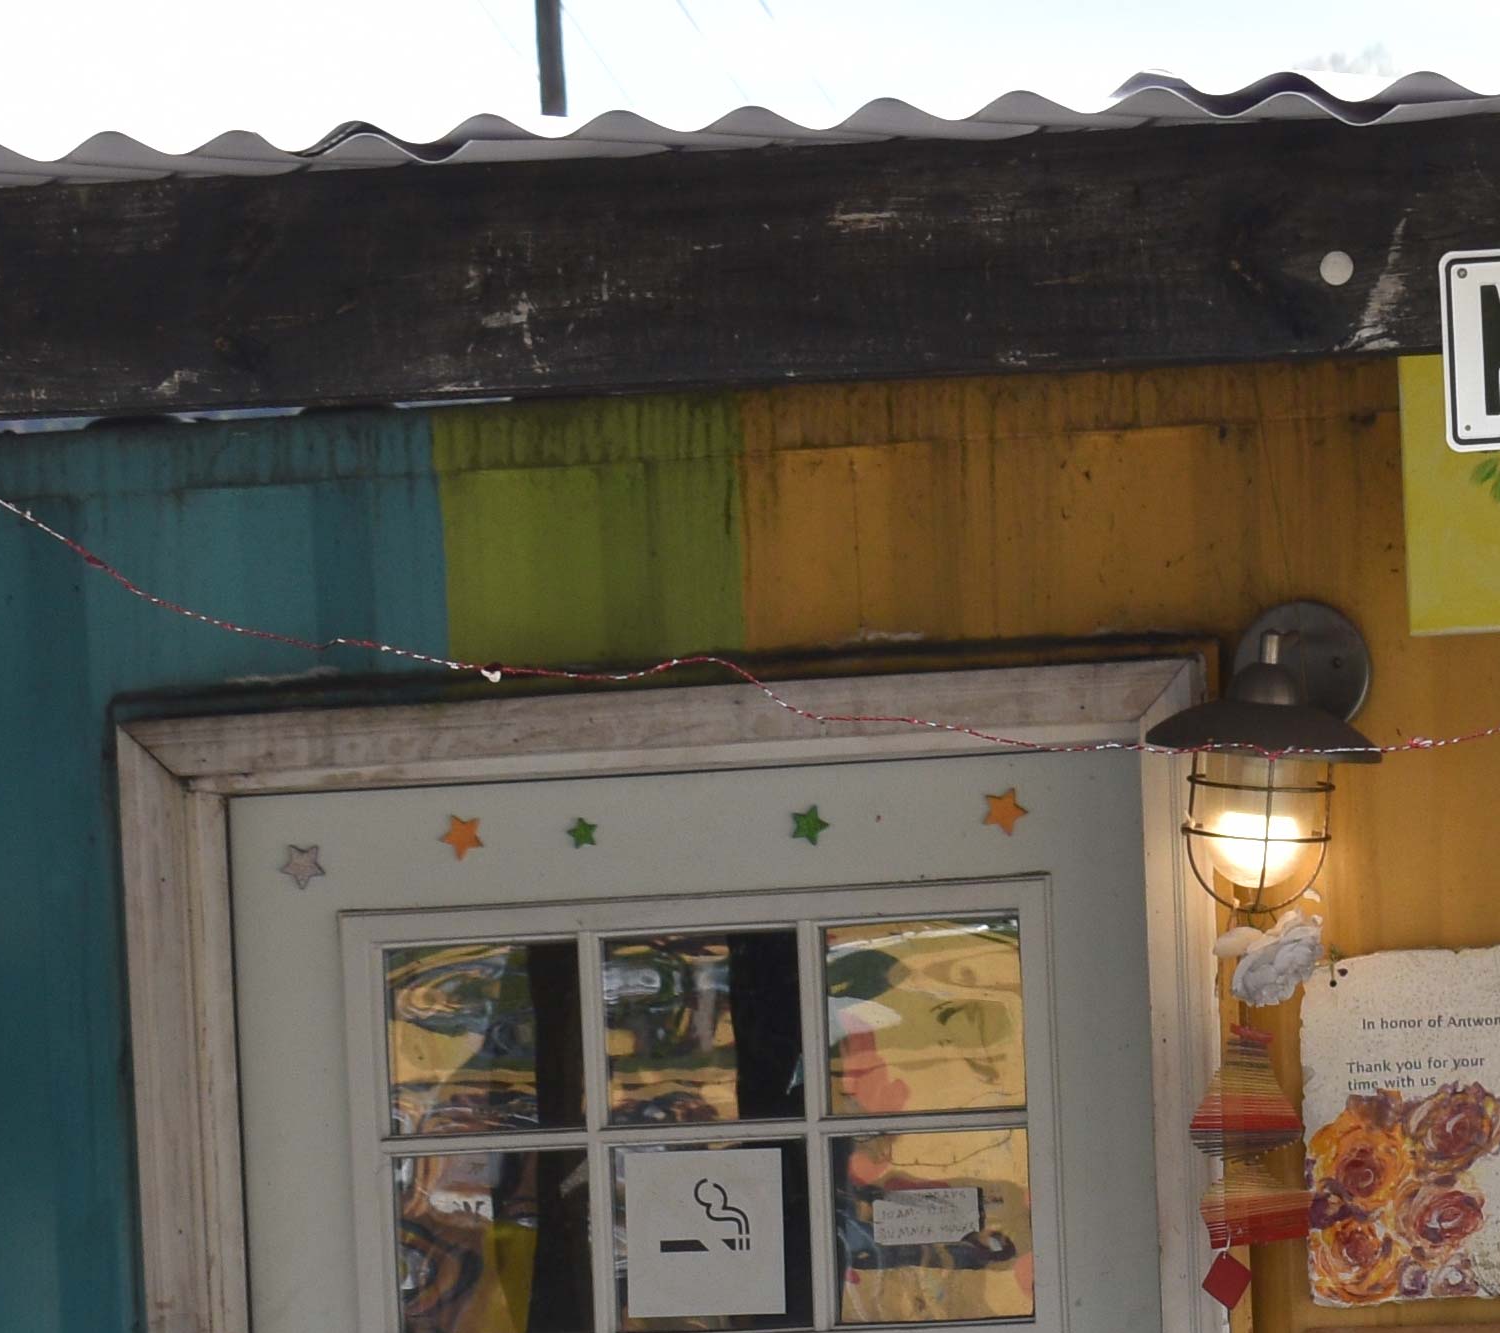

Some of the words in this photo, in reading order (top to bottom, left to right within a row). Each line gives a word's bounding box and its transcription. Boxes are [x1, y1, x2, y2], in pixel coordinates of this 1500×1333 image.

[1362, 1018, 1376, 1030] In
[1380, 1016, 1422, 1030] honor
[1428, 1015, 1443, 1028] of
[1447, 1014, 1500, 1028] Antwon
[1346, 1059, 1391, 1074] Thank
[1396, 1058, 1422, 1074] you
[1428, 1055, 1448, 1070] for
[1453, 1055, 1485, 1072] your
[1348, 1078, 1379, 1091] time
[1384, 1074, 1415, 1089] with
[1421, 1075, 1437, 1087] us
